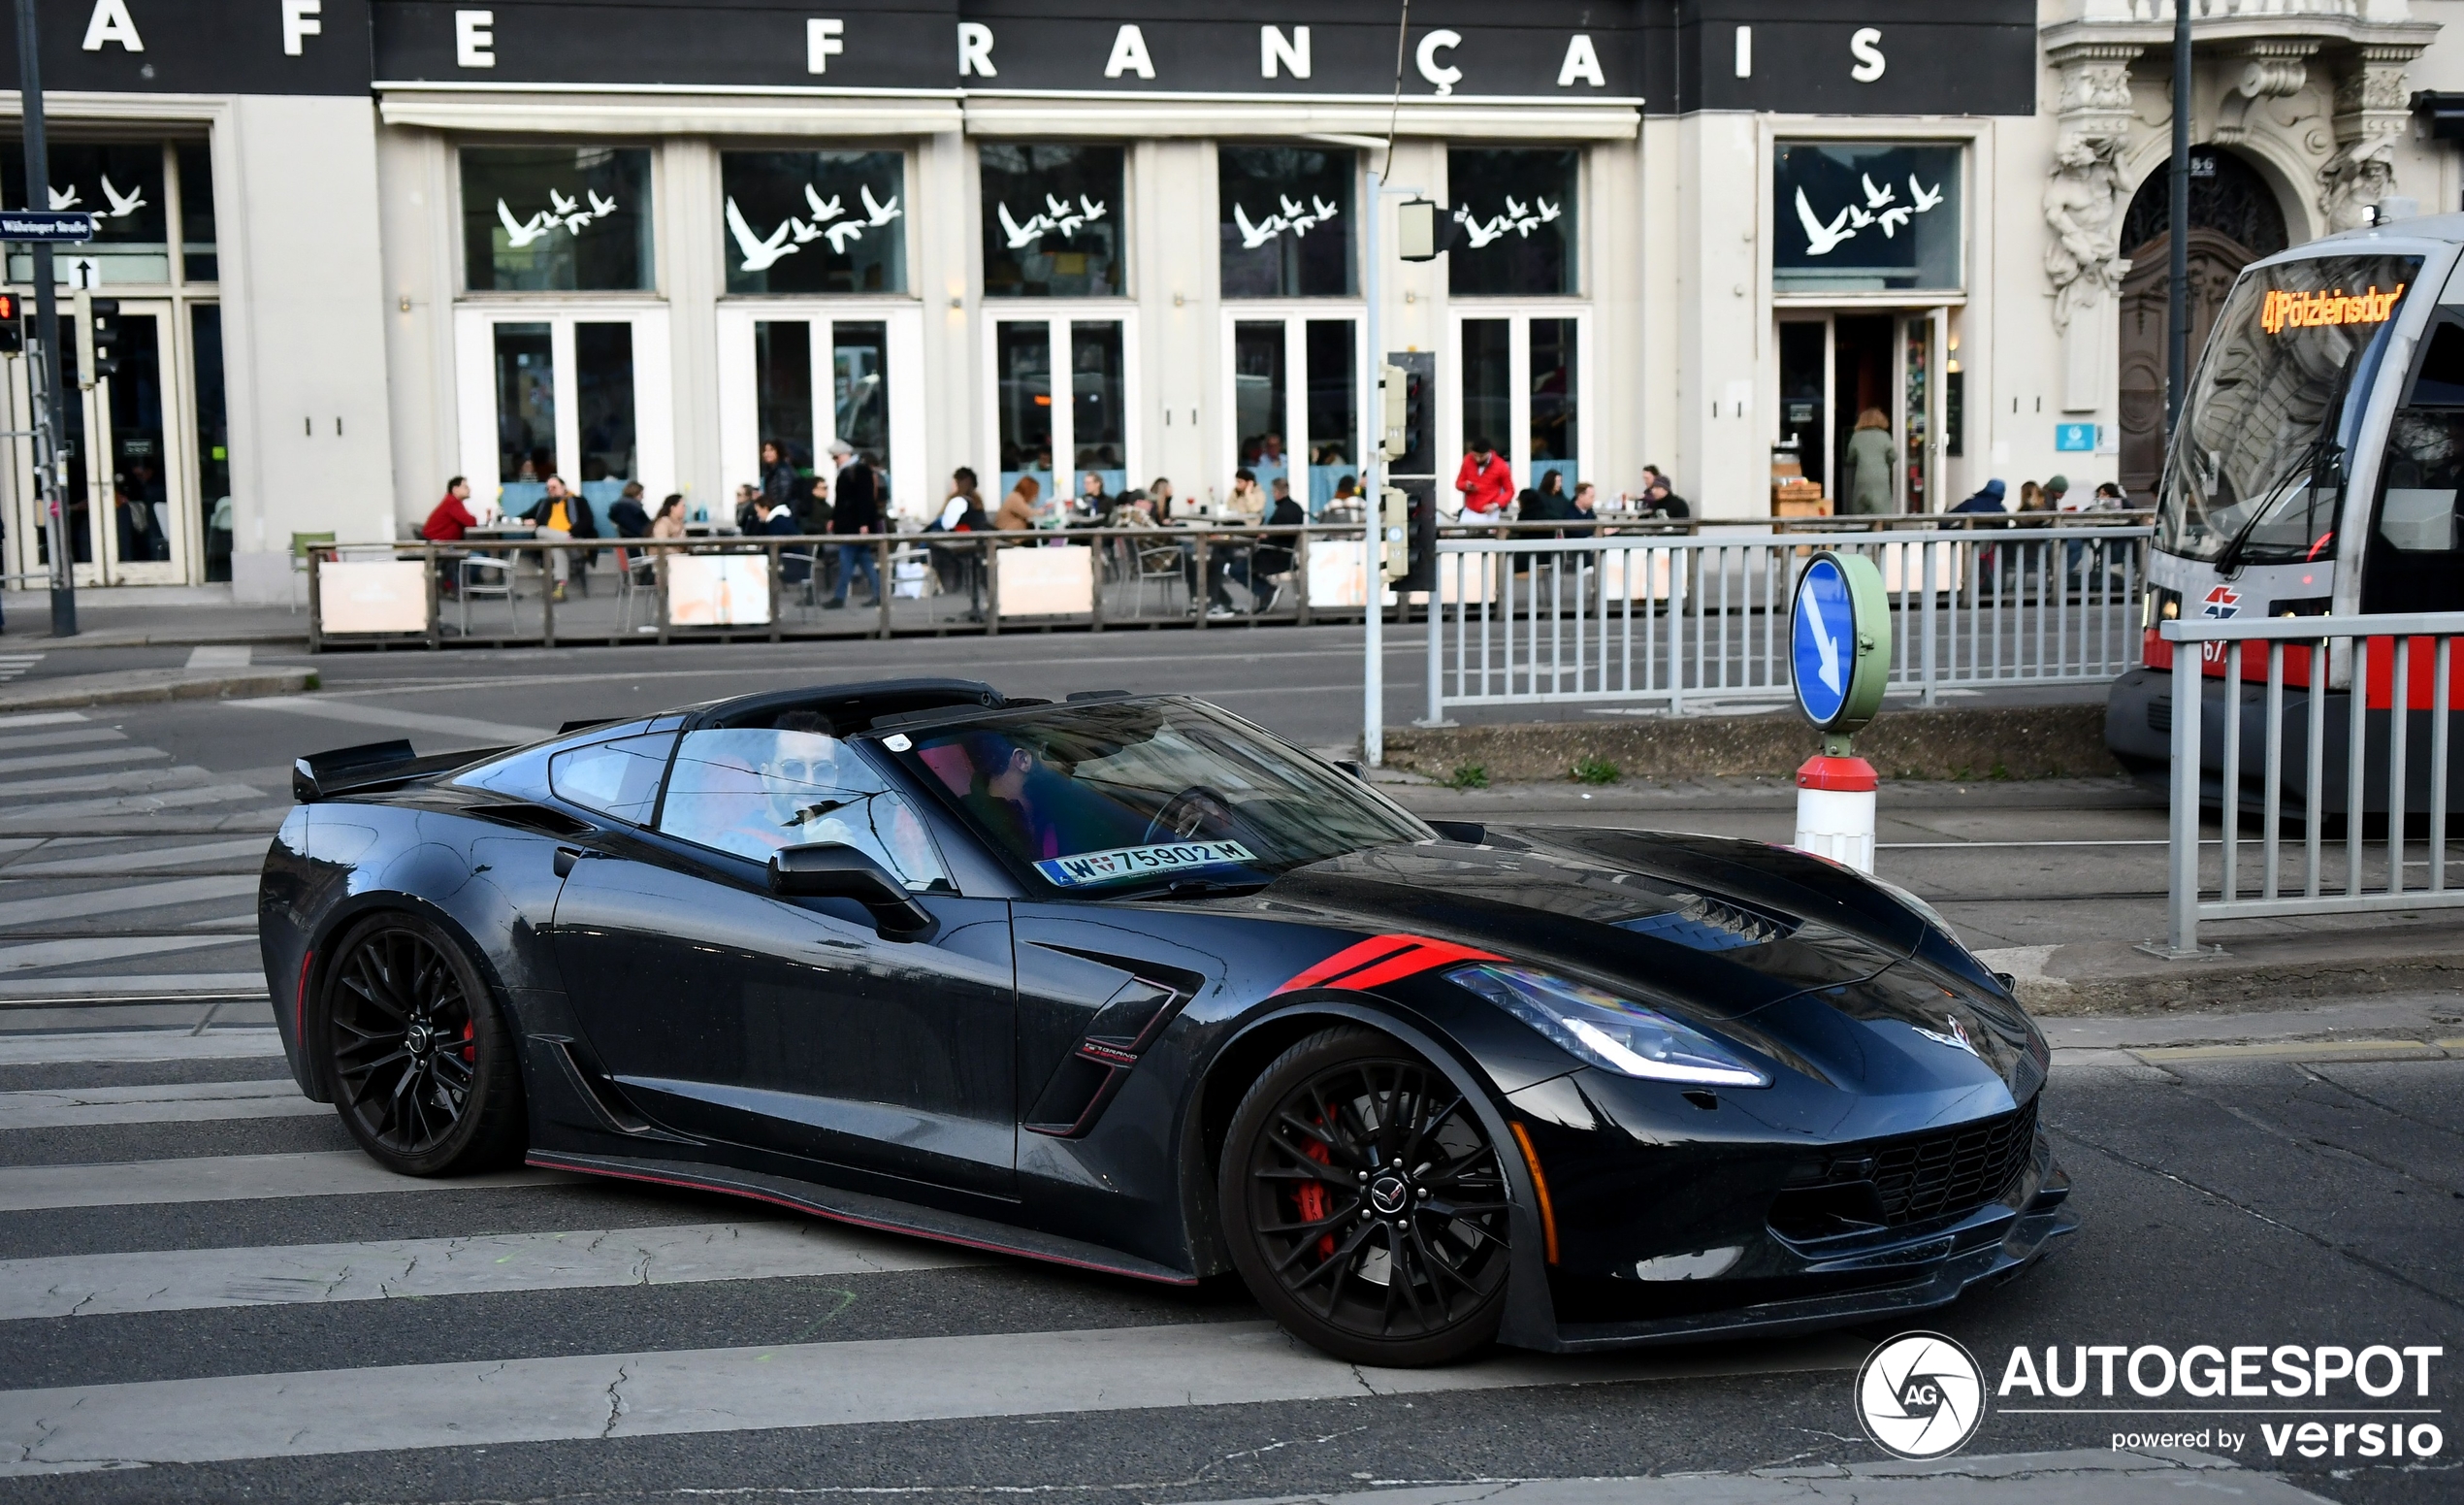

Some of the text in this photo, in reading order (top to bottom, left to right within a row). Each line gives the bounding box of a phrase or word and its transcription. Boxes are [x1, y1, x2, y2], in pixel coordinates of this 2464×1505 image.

[806, 18, 1886, 97] FRANÇAIS
[1064, 859, 1096, 877] W
[1100, 1052, 1135, 1063] SPORT
[1101, 1047, 1138, 1060] GRAND
